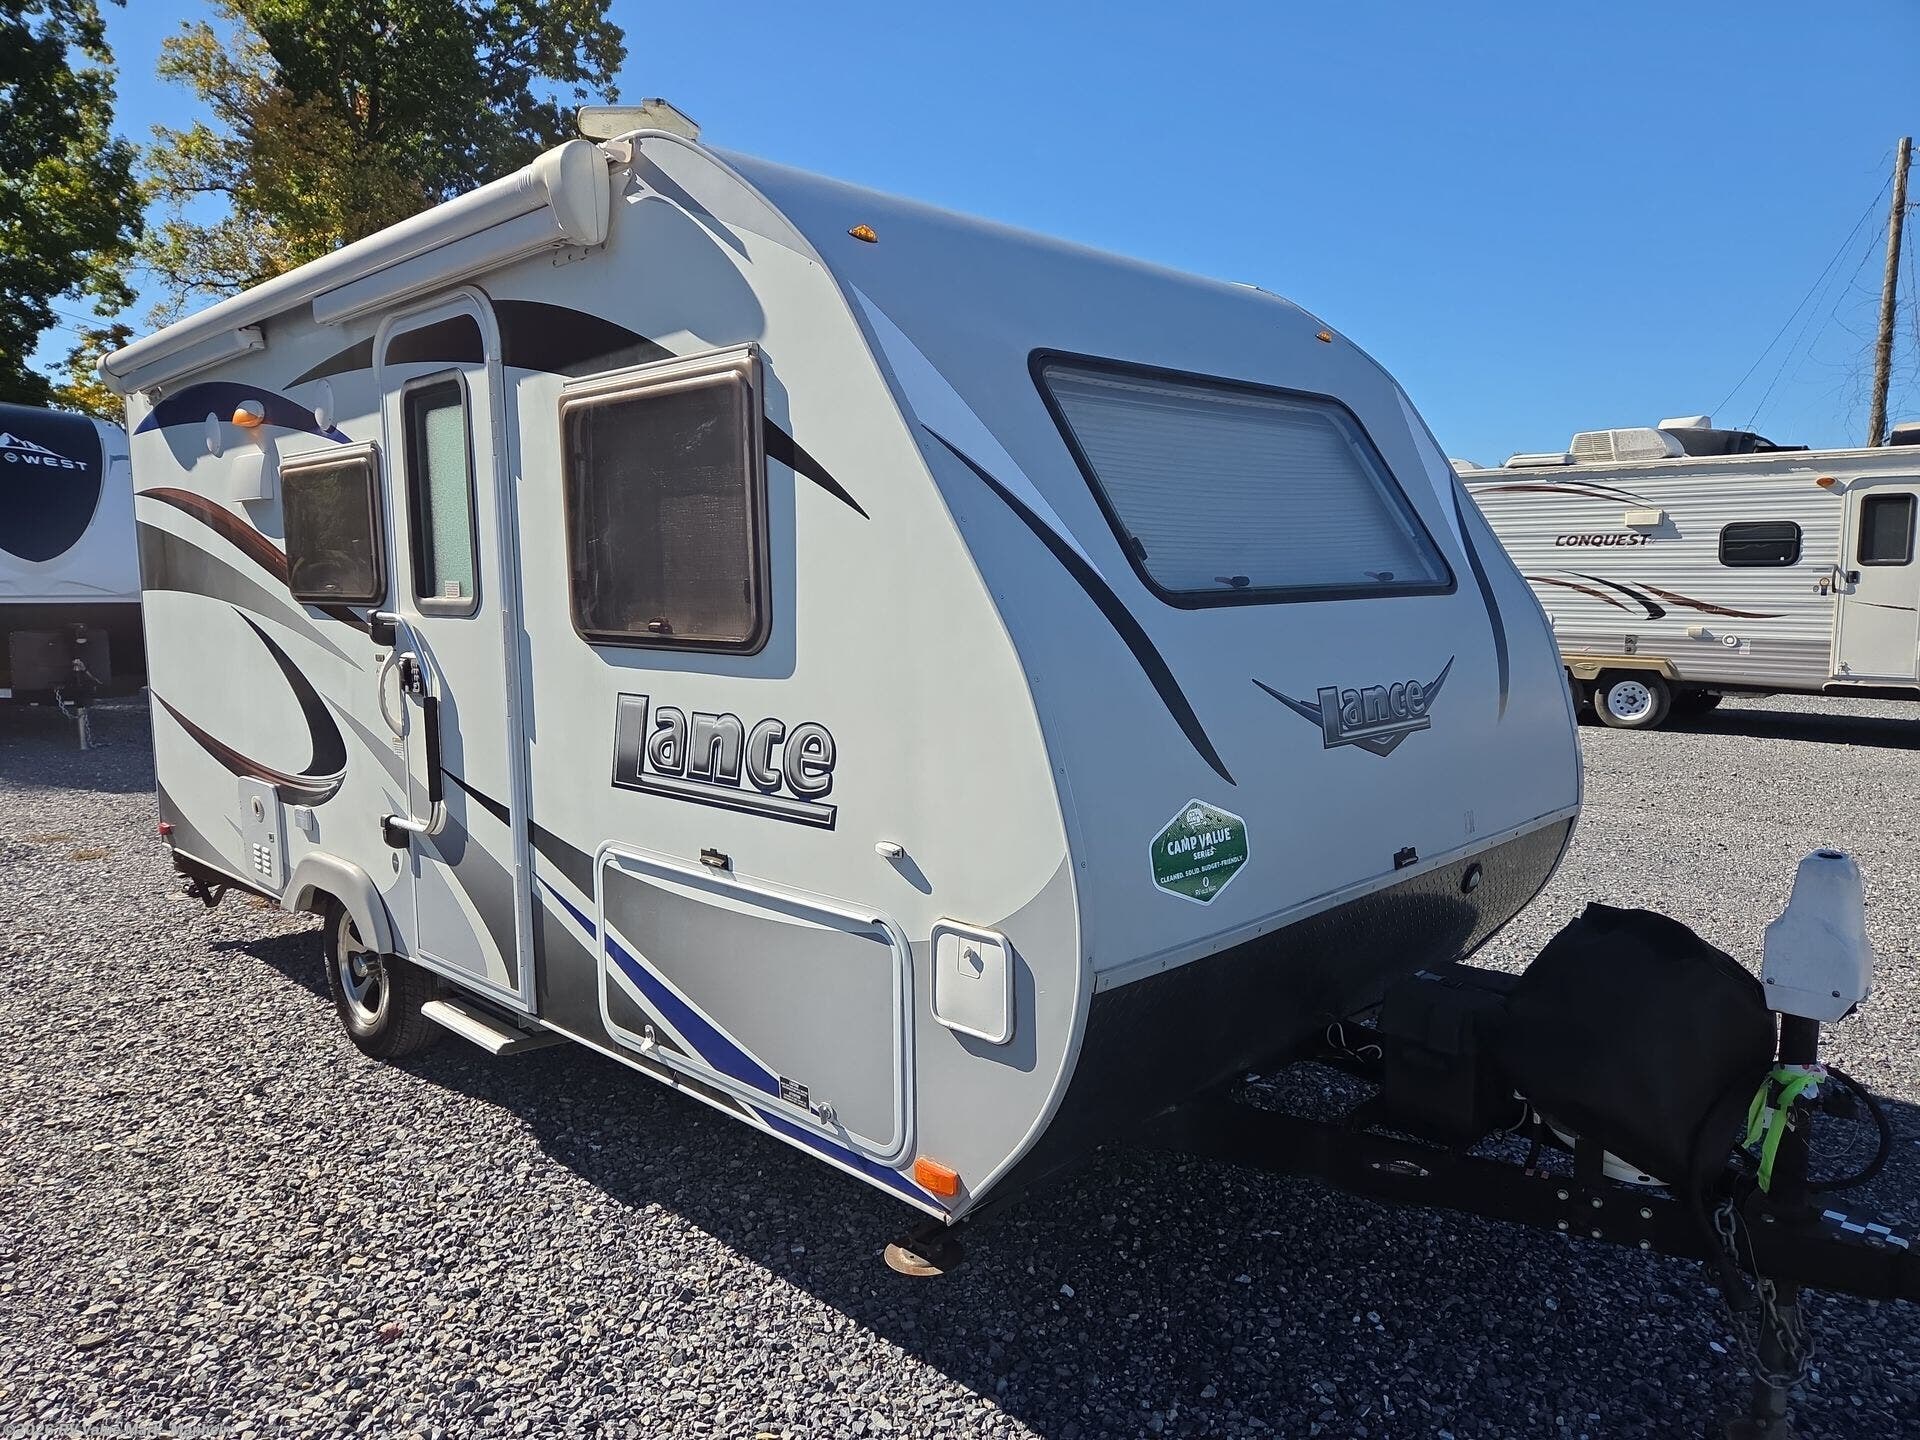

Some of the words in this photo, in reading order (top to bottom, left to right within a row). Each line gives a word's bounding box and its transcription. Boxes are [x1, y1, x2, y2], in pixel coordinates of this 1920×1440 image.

[21, 454, 88, 471] WEST
[1555, 534, 1652, 546] CONQUEST
[1318, 680, 1431, 749] Lance
[612, 692, 838, 832] Lance
[1167, 836, 1197, 856] CAMP
[1199, 827, 1231, 850] VALUE
[1193, 849, 1215, 861] SERIES
